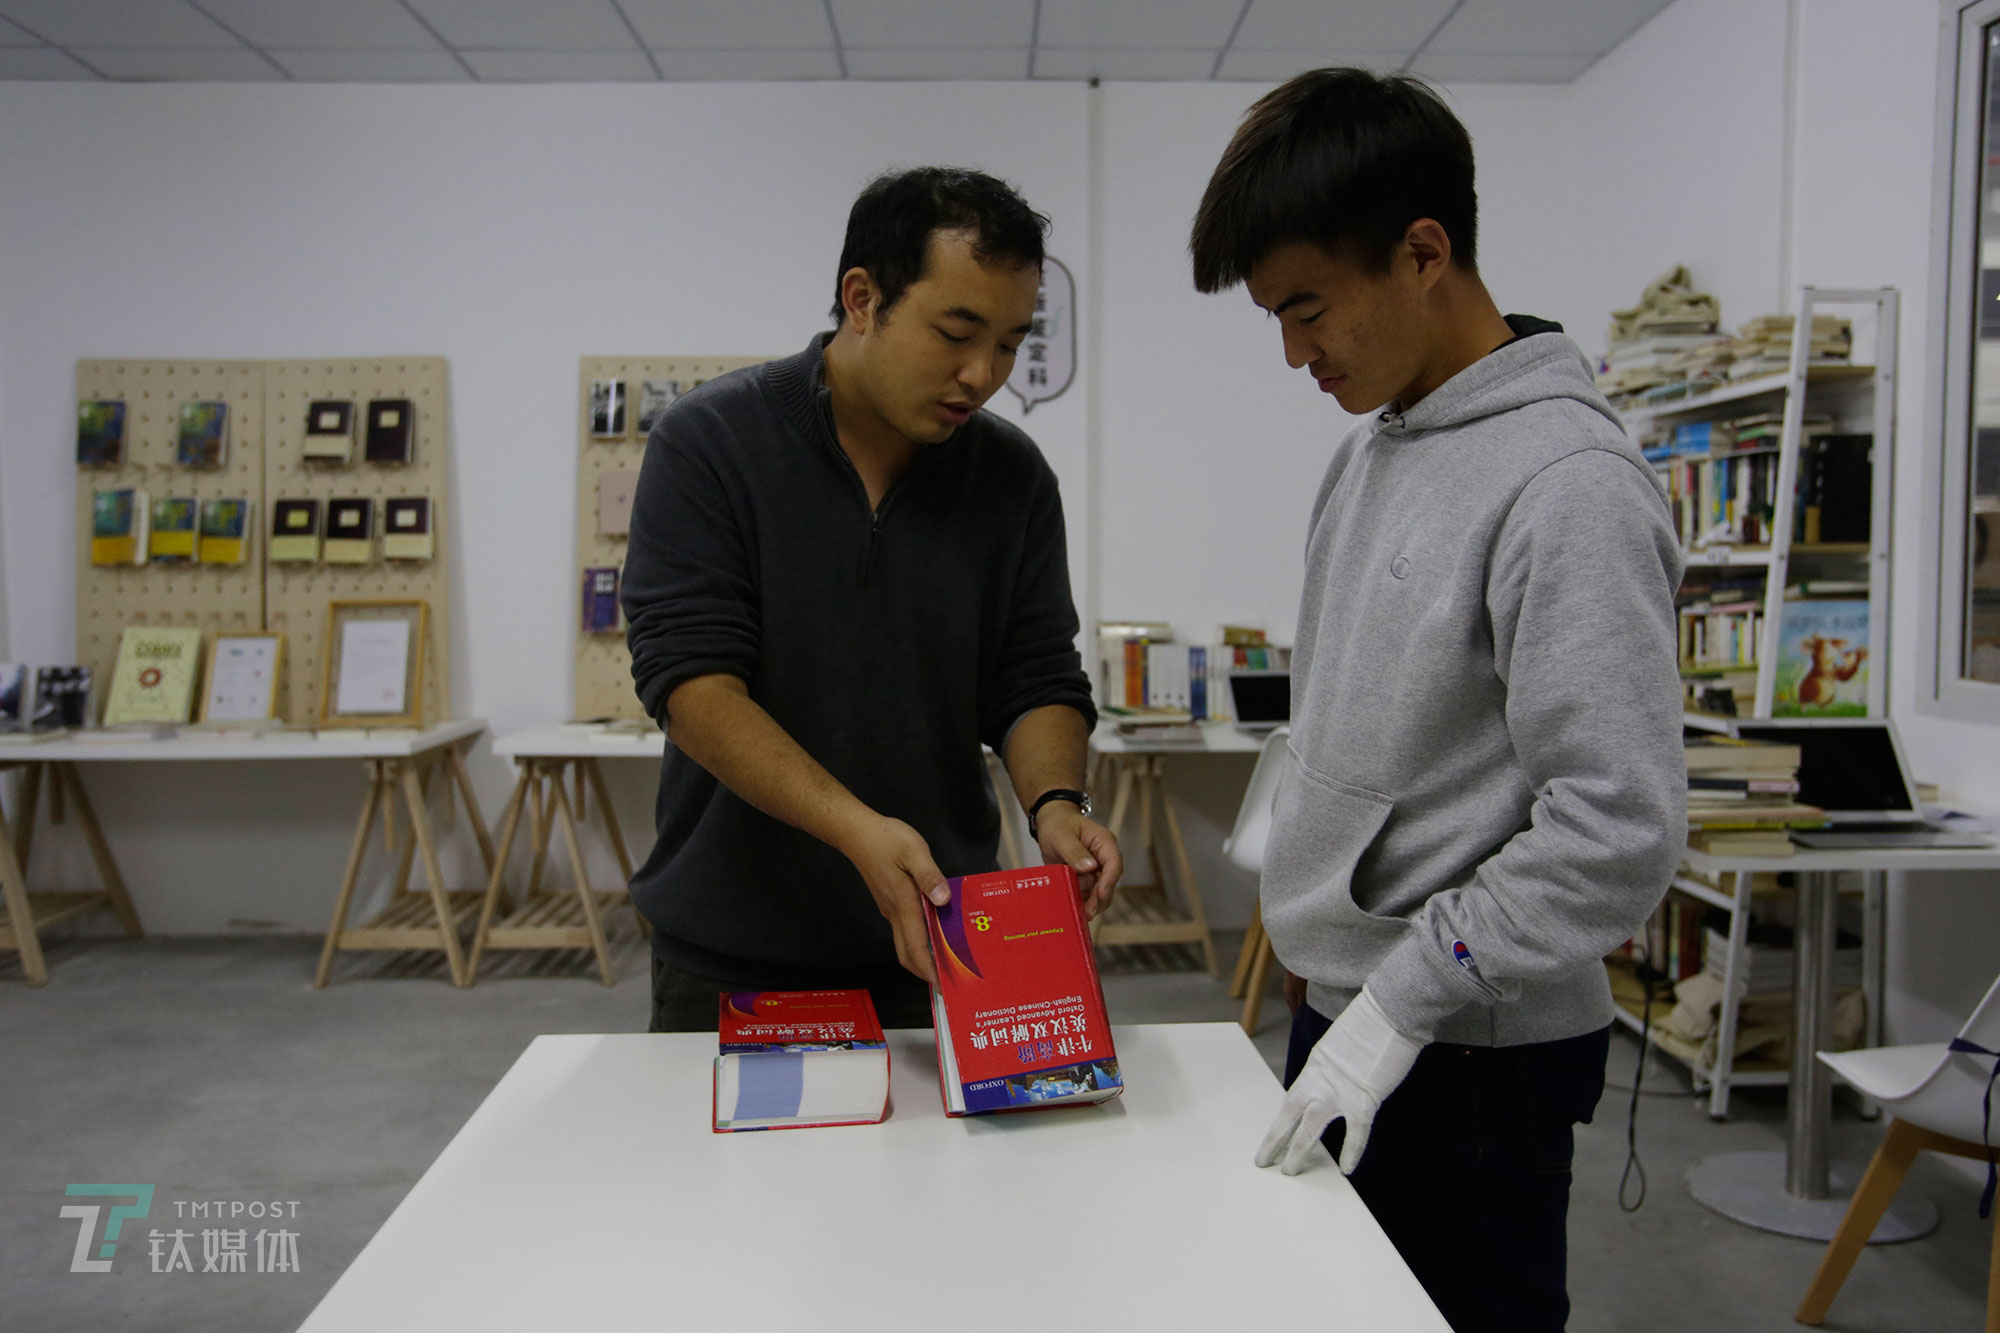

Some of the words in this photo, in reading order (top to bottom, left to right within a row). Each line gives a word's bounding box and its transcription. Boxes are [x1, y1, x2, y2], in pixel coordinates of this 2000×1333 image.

[982, 889, 1010, 897] OXFORD
[1018, 995, 1082, 1011] English-Chinese
[1057, 1004, 1084, 1015] Oxford
[974, 1006, 1015, 1019] Dictionary
[1016, 1009, 1056, 1022] Advanced
[975, 1016, 1015, 1029] Learner's
[969, 1013, 1088, 1050] 英汉双解词典
[1017, 1034, 1092, 1064] 牛津高阶
[969, 1079, 1004, 1092] OXFORD
